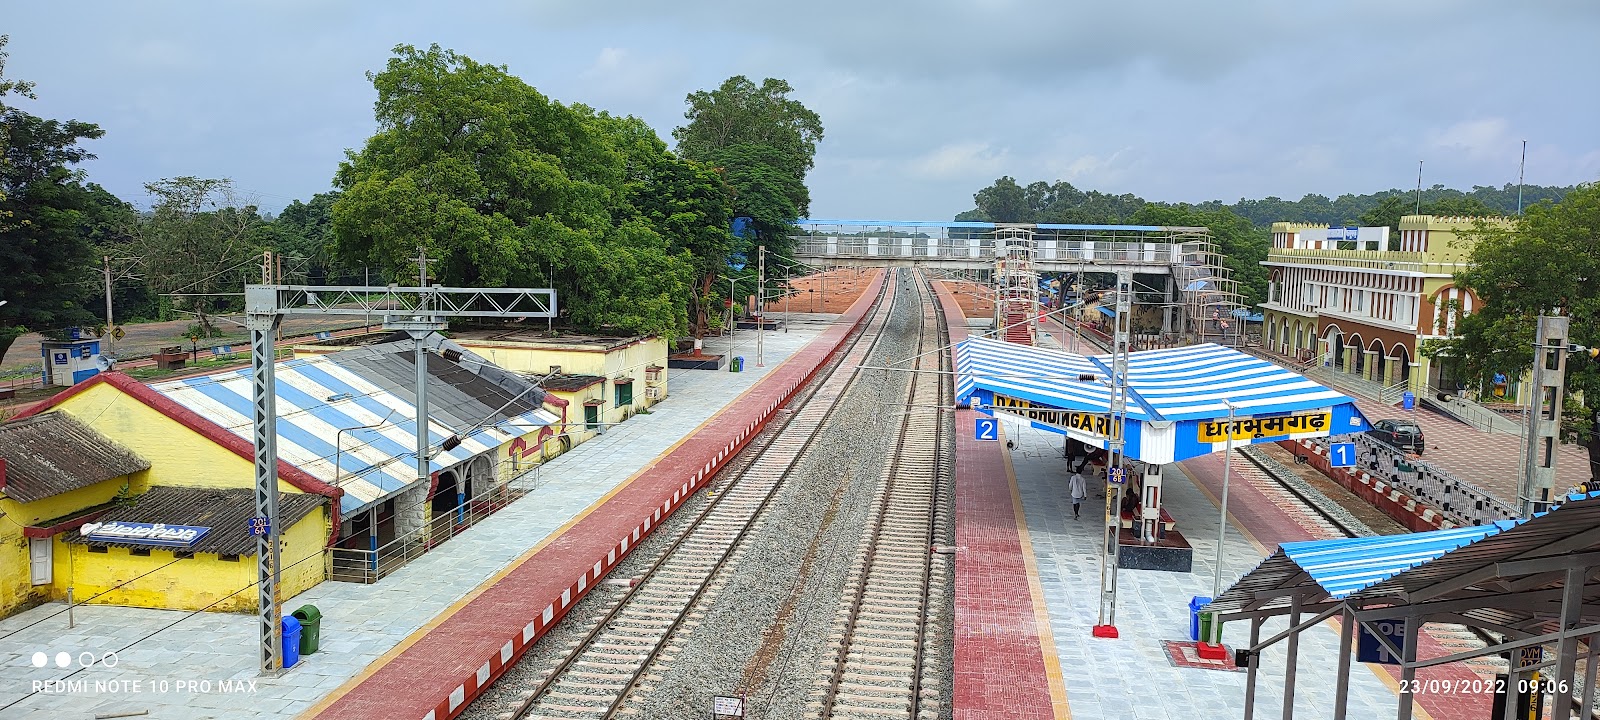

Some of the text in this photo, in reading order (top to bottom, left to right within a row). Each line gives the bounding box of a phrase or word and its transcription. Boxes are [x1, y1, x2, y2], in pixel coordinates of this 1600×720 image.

[115, 328, 122, 338] 2
[980, 421, 994, 439] 2
[1337, 446, 1347, 465] 1
